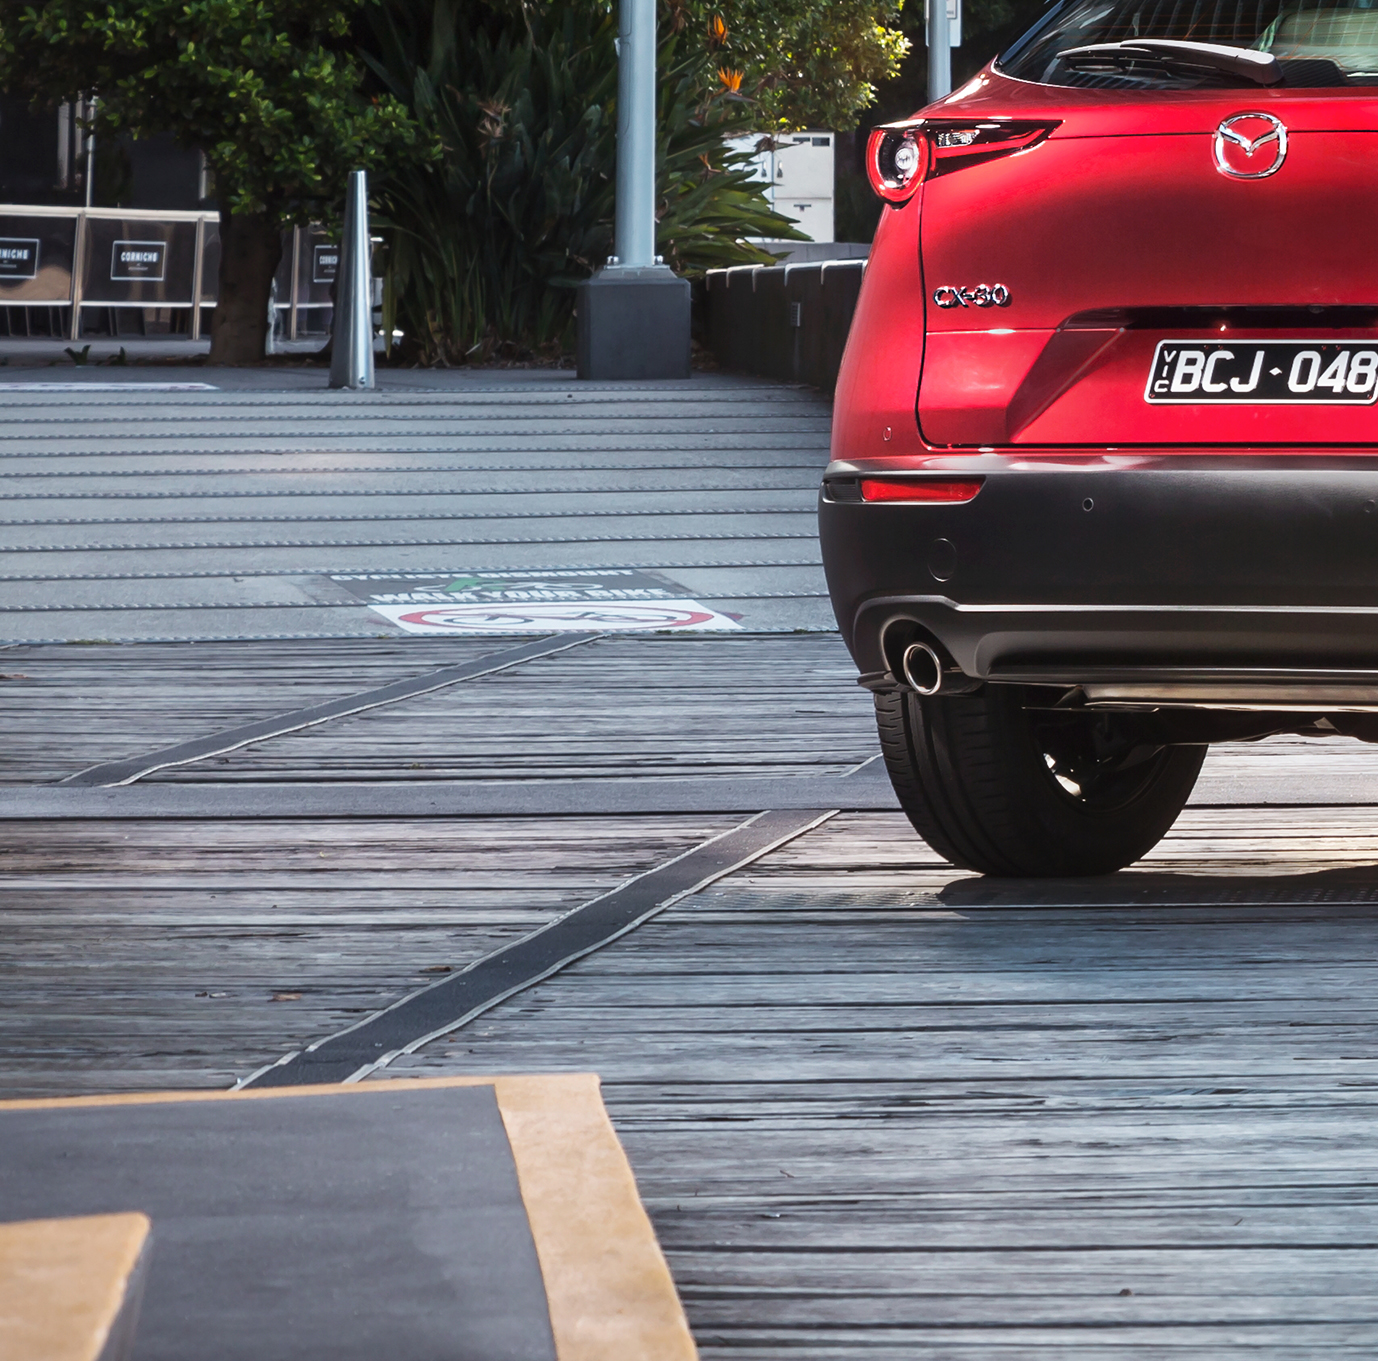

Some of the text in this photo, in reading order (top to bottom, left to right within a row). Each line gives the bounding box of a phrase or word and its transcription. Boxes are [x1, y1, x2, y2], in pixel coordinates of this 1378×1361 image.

[120, 251, 158, 262] CORNICHE
[933, 283, 1010, 308] CX-30
[1154, 350, 1177, 393] VIC
[369, 588, 672, 605] WALK YOUR BIKE
